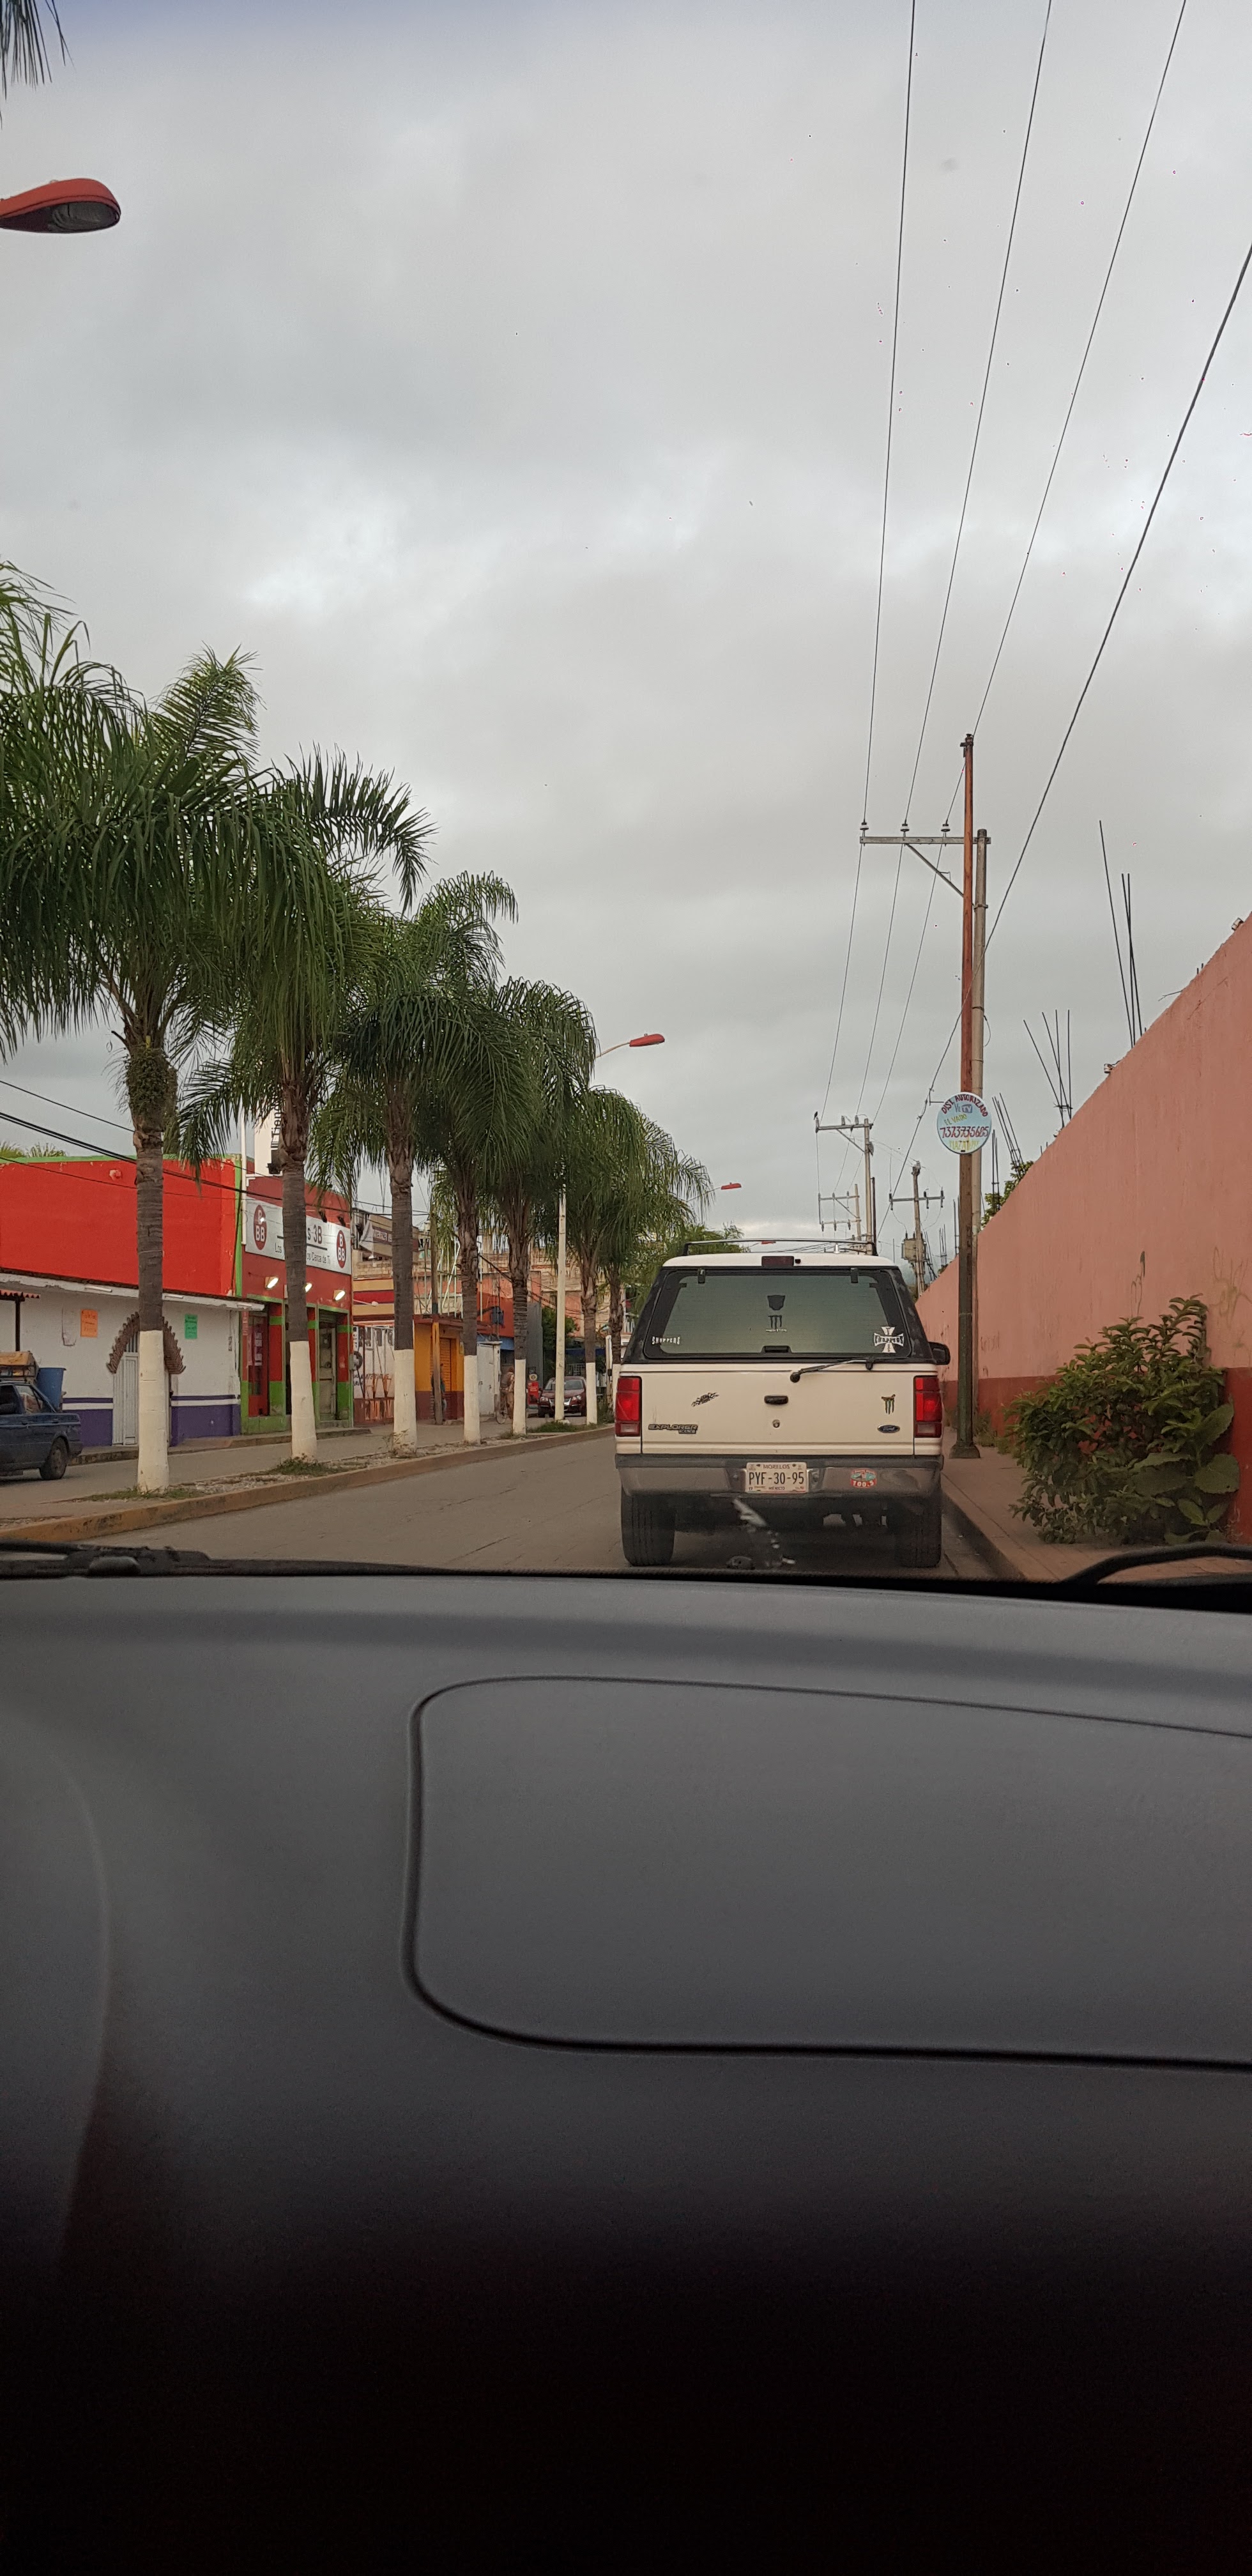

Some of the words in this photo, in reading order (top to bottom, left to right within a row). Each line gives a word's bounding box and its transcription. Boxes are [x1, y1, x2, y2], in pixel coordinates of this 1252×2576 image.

[954, 1094, 989, 1117] AUTORIZADO
[314, 1224, 323, 1245] 3B
[749, 1471, 804, 1485] PYF-30-95
